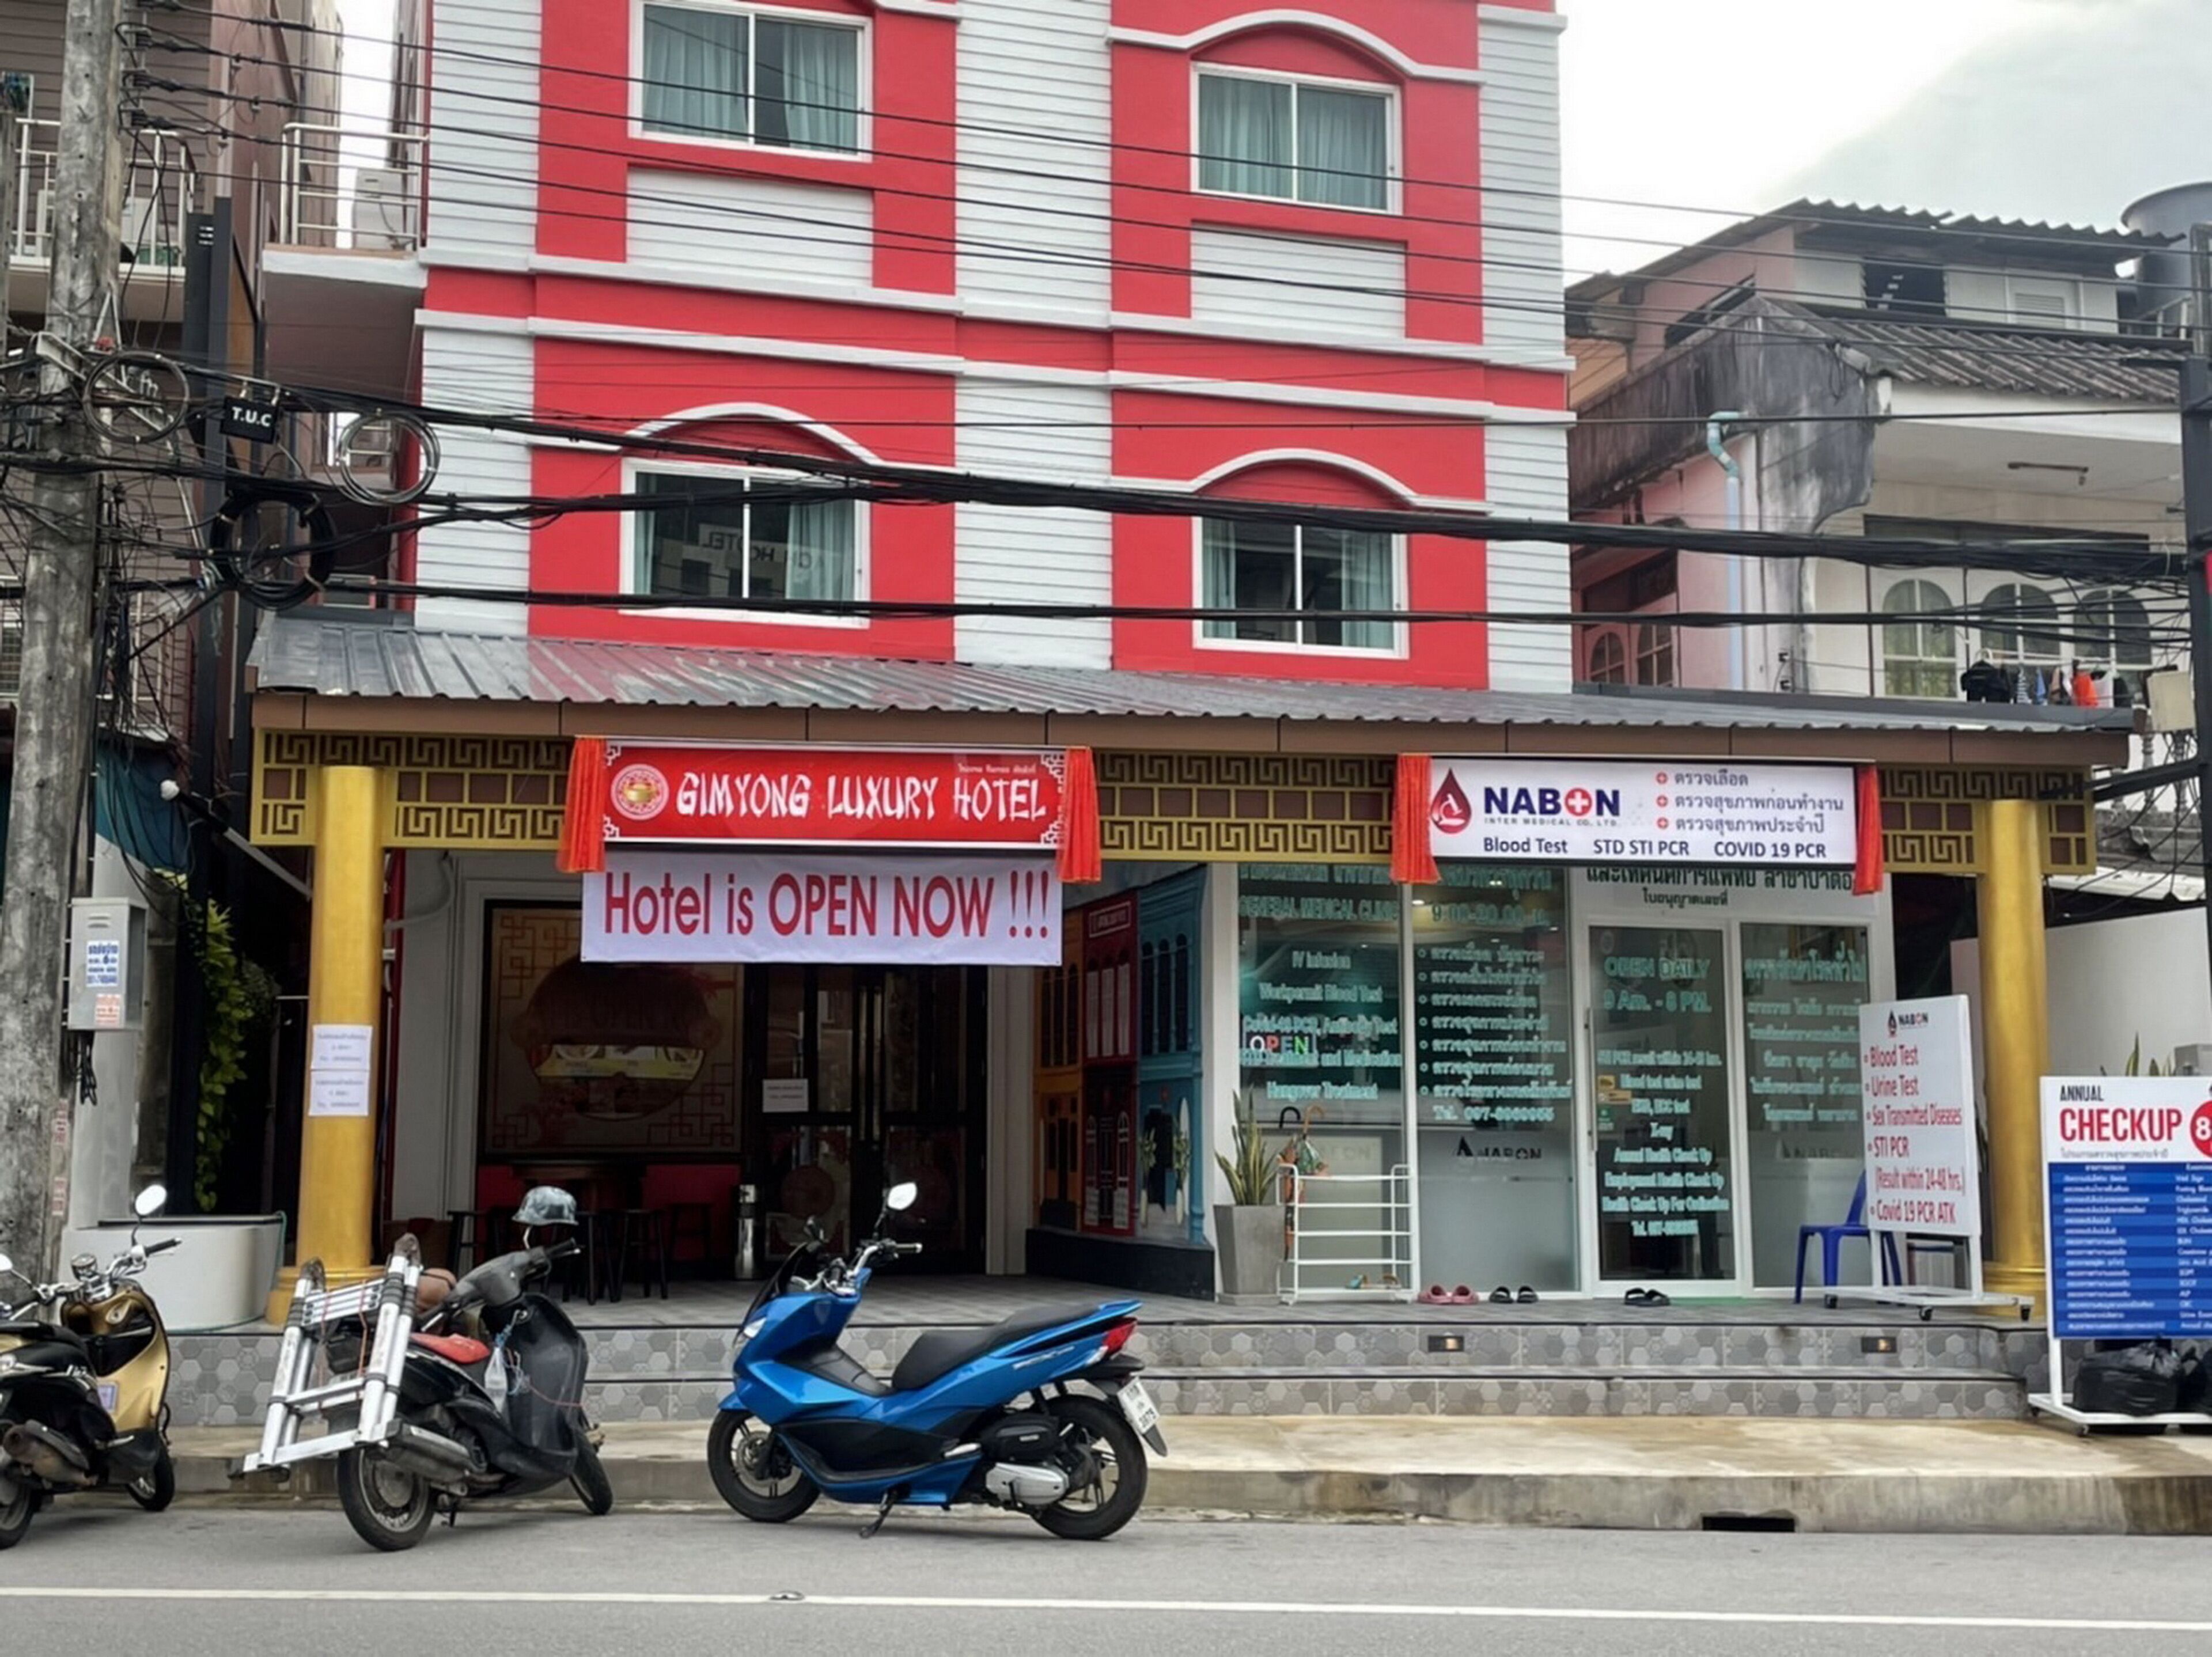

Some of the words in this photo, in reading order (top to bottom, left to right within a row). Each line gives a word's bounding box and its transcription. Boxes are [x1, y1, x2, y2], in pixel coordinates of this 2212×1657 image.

[232, 407, 272, 427] T.U.C
[1675, 769, 1749, 787] ตรวจเลือด
[676, 772, 812, 818] GIMYONG
[827, 775, 938, 820] LUXURY
[953, 777, 1047, 821] HOTEL
[1675, 787, 1844, 813] ตรวจสุขภาพก่อนทำงาน
[1676, 814, 1825, 836] ตรวจสุขภาพประจำปี
[1484, 837, 1531, 853] Blood
[1535, 838, 1568, 854] Test
[1594, 839, 1625, 855] STD
[1630, 840, 1653, 855] STI
[1658, 841, 1690, 856] PCR
[1714, 841, 1766, 857] COVID
[1771, 843, 1790, 858] 19
[1795, 843, 1827, 859] PCR
[605, 872, 710, 935] Hotel
[727, 875, 753, 936] is
[768, 872, 877, 937] OPEN
[893, 875, 995, 938] NOW
[1009, 870, 1049, 939] !!!
[1659, 957, 1710, 980] DAILY
[1250, 1036, 1309, 1055] OPEN
[1870, 1044, 1897, 1067] Blood
[1899, 1044, 1918, 1066] Test
[1871, 1075, 1897, 1097] Urine
[1899, 1074, 1919, 1096] Test
[2060, 1085, 2104, 1101] ANNUAL
[1873, 1104, 1885, 1125] Sex
[1886, 1104, 1929, 1125] Transmitted
[1930, 1103, 1962, 1125] Diseases
[2059, 1108, 2183, 1142] CHECKUP
[1873, 1136, 1888, 1157] STI
[1890, 1136, 1909, 1158] PCR
[1877, 1199, 1902, 1220] Covid
[1903, 1200, 1915, 1222] 19
[1917, 1200, 1935, 1222] PCR
[1937, 1201, 1956, 1224] ATK
